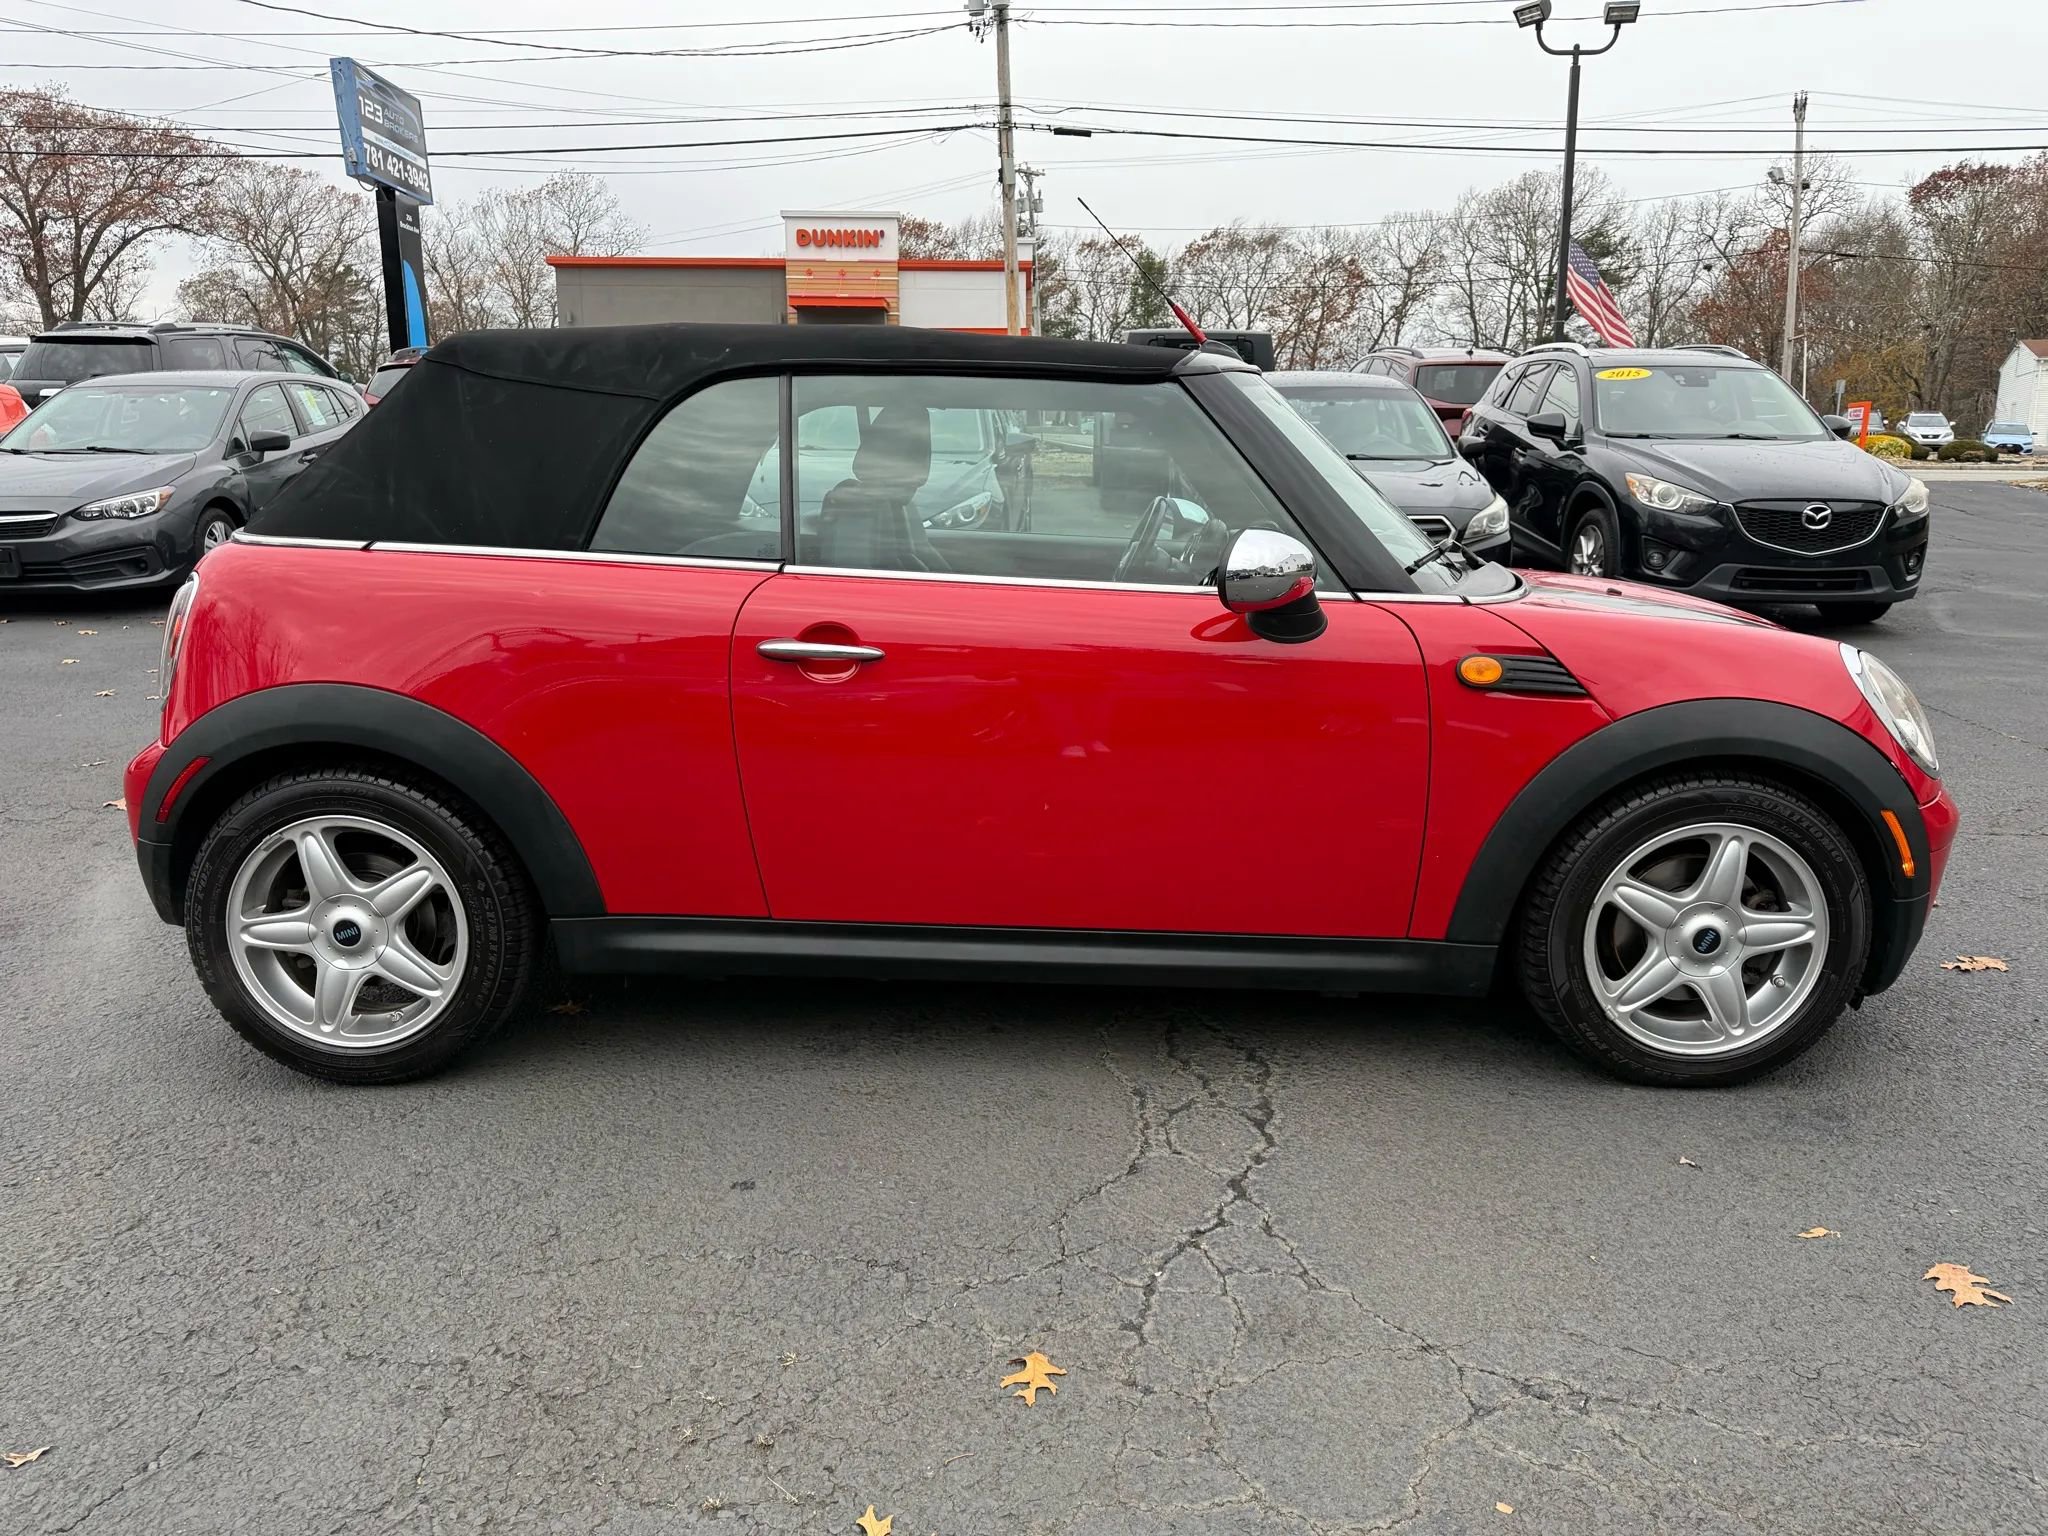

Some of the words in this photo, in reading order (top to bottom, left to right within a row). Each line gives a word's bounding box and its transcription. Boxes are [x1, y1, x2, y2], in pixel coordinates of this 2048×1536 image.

[358, 95, 383, 124] 123
[384, 108, 404, 124] AUTO
[384, 119, 419, 143] BROKERS
[363, 143, 384, 171] 781
[796, 228, 885, 248] DUNKIN'
[1607, 369, 1641, 378] 2015
[335, 926, 360, 941] MINI
[1697, 929, 1717, 953] MINI
